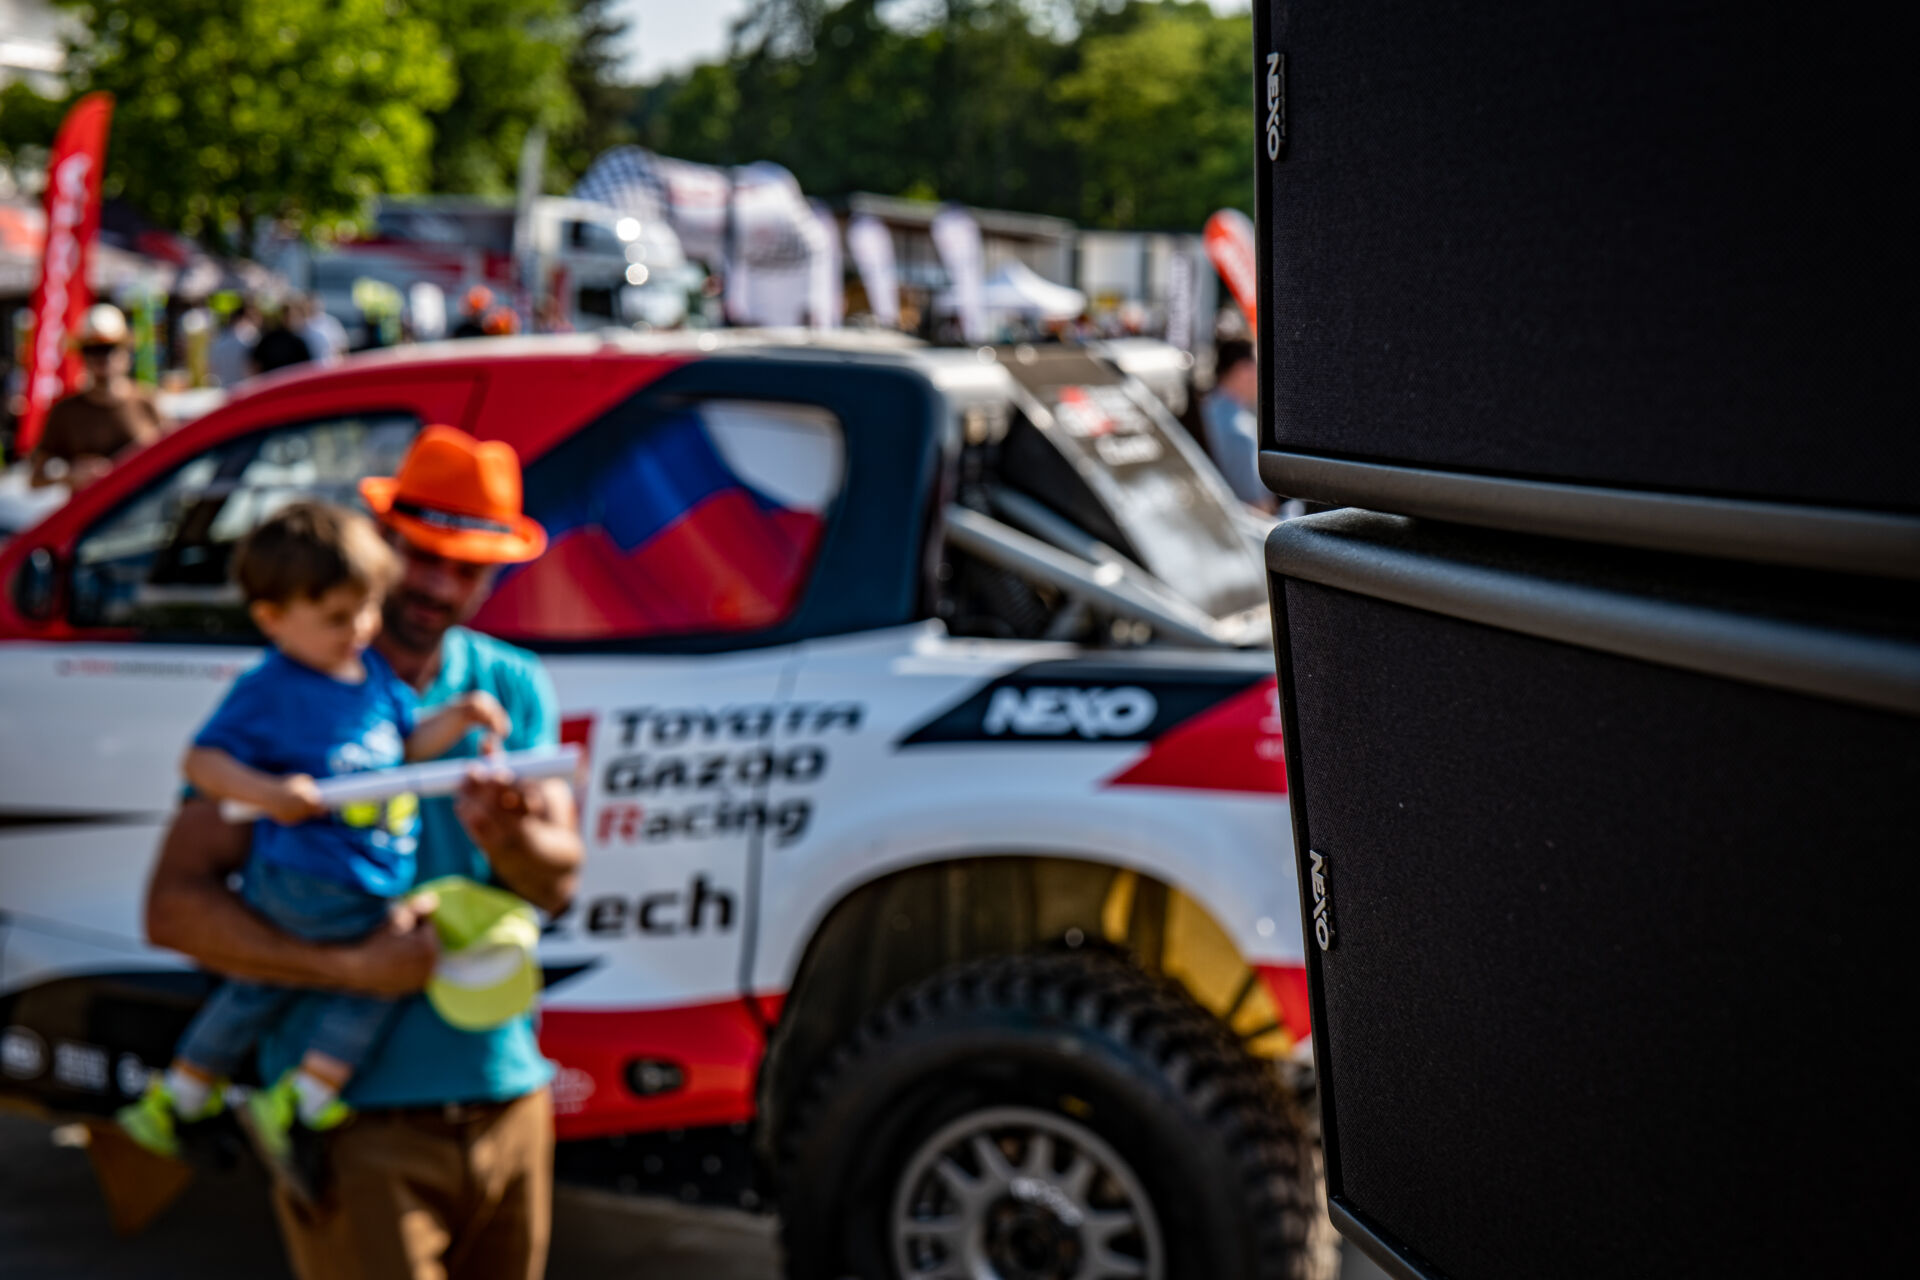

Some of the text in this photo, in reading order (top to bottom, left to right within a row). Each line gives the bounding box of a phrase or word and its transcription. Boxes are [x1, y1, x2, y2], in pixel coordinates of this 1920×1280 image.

[1266, 51, 1280, 161] NEXO
[983, 686, 1157, 738] NEXO
[604, 747, 827, 795] GAZOO
[596, 798, 813, 848] Racing
[1309, 849, 1330, 952] NEXO
